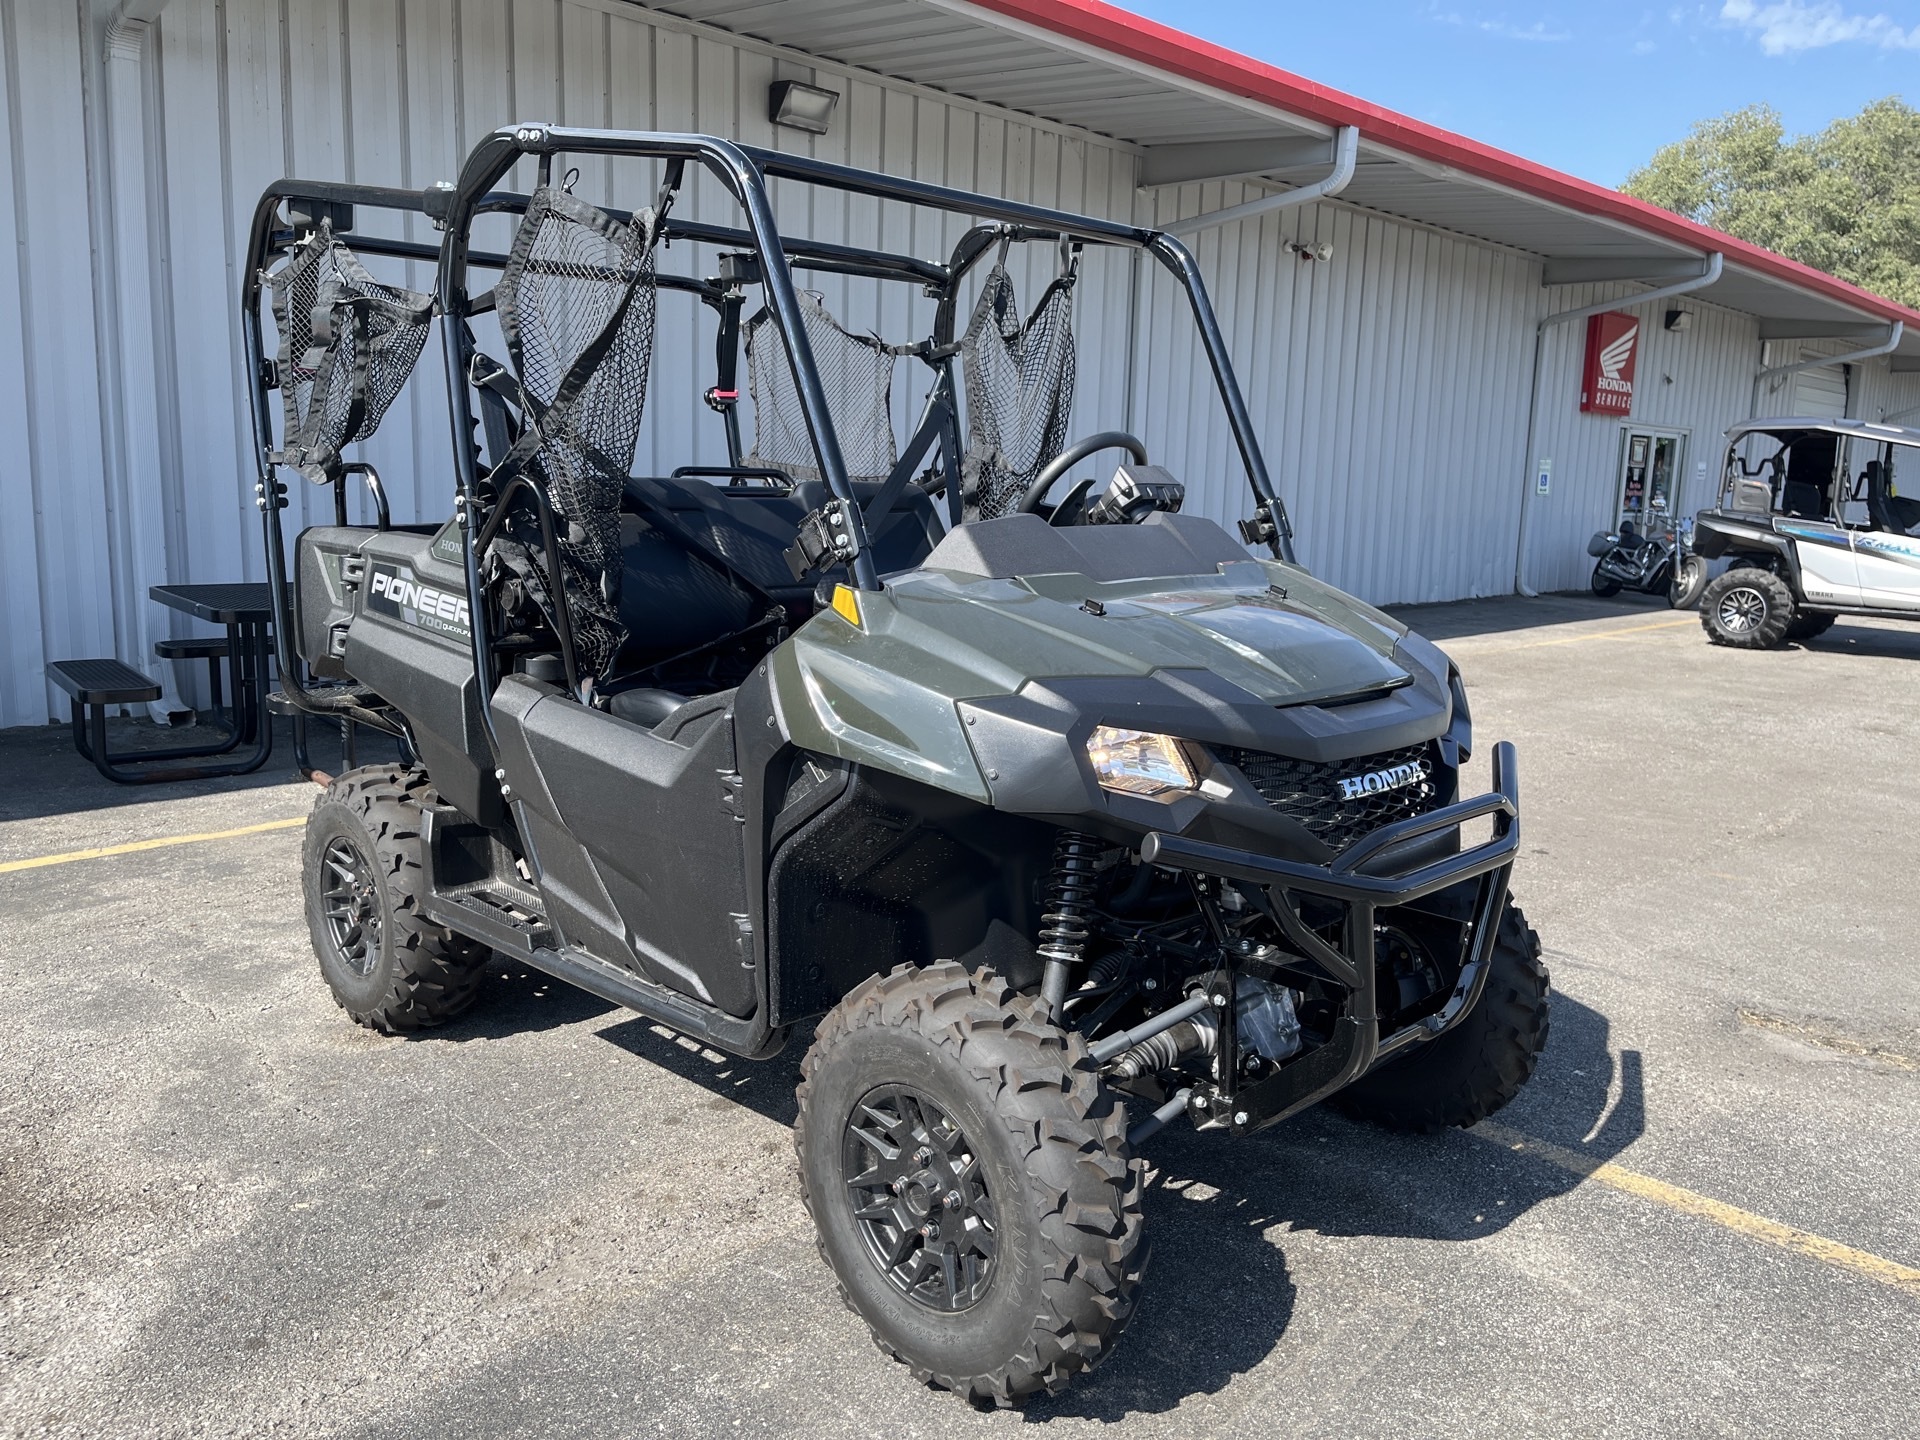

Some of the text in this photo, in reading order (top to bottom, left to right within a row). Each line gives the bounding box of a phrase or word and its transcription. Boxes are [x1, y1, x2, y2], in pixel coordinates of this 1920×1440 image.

[1597, 377, 1632, 393] HONDA
[1595, 392, 1632, 409] SERVICE
[441, 540, 463, 554] HON
[371, 572, 470, 626] PIONEER
[1807, 591, 1834, 599] YAMAHA
[419, 614, 442, 630] 700
[1337, 761, 1426, 800] HONDA
[997, 1163, 1028, 1307] KENDA
